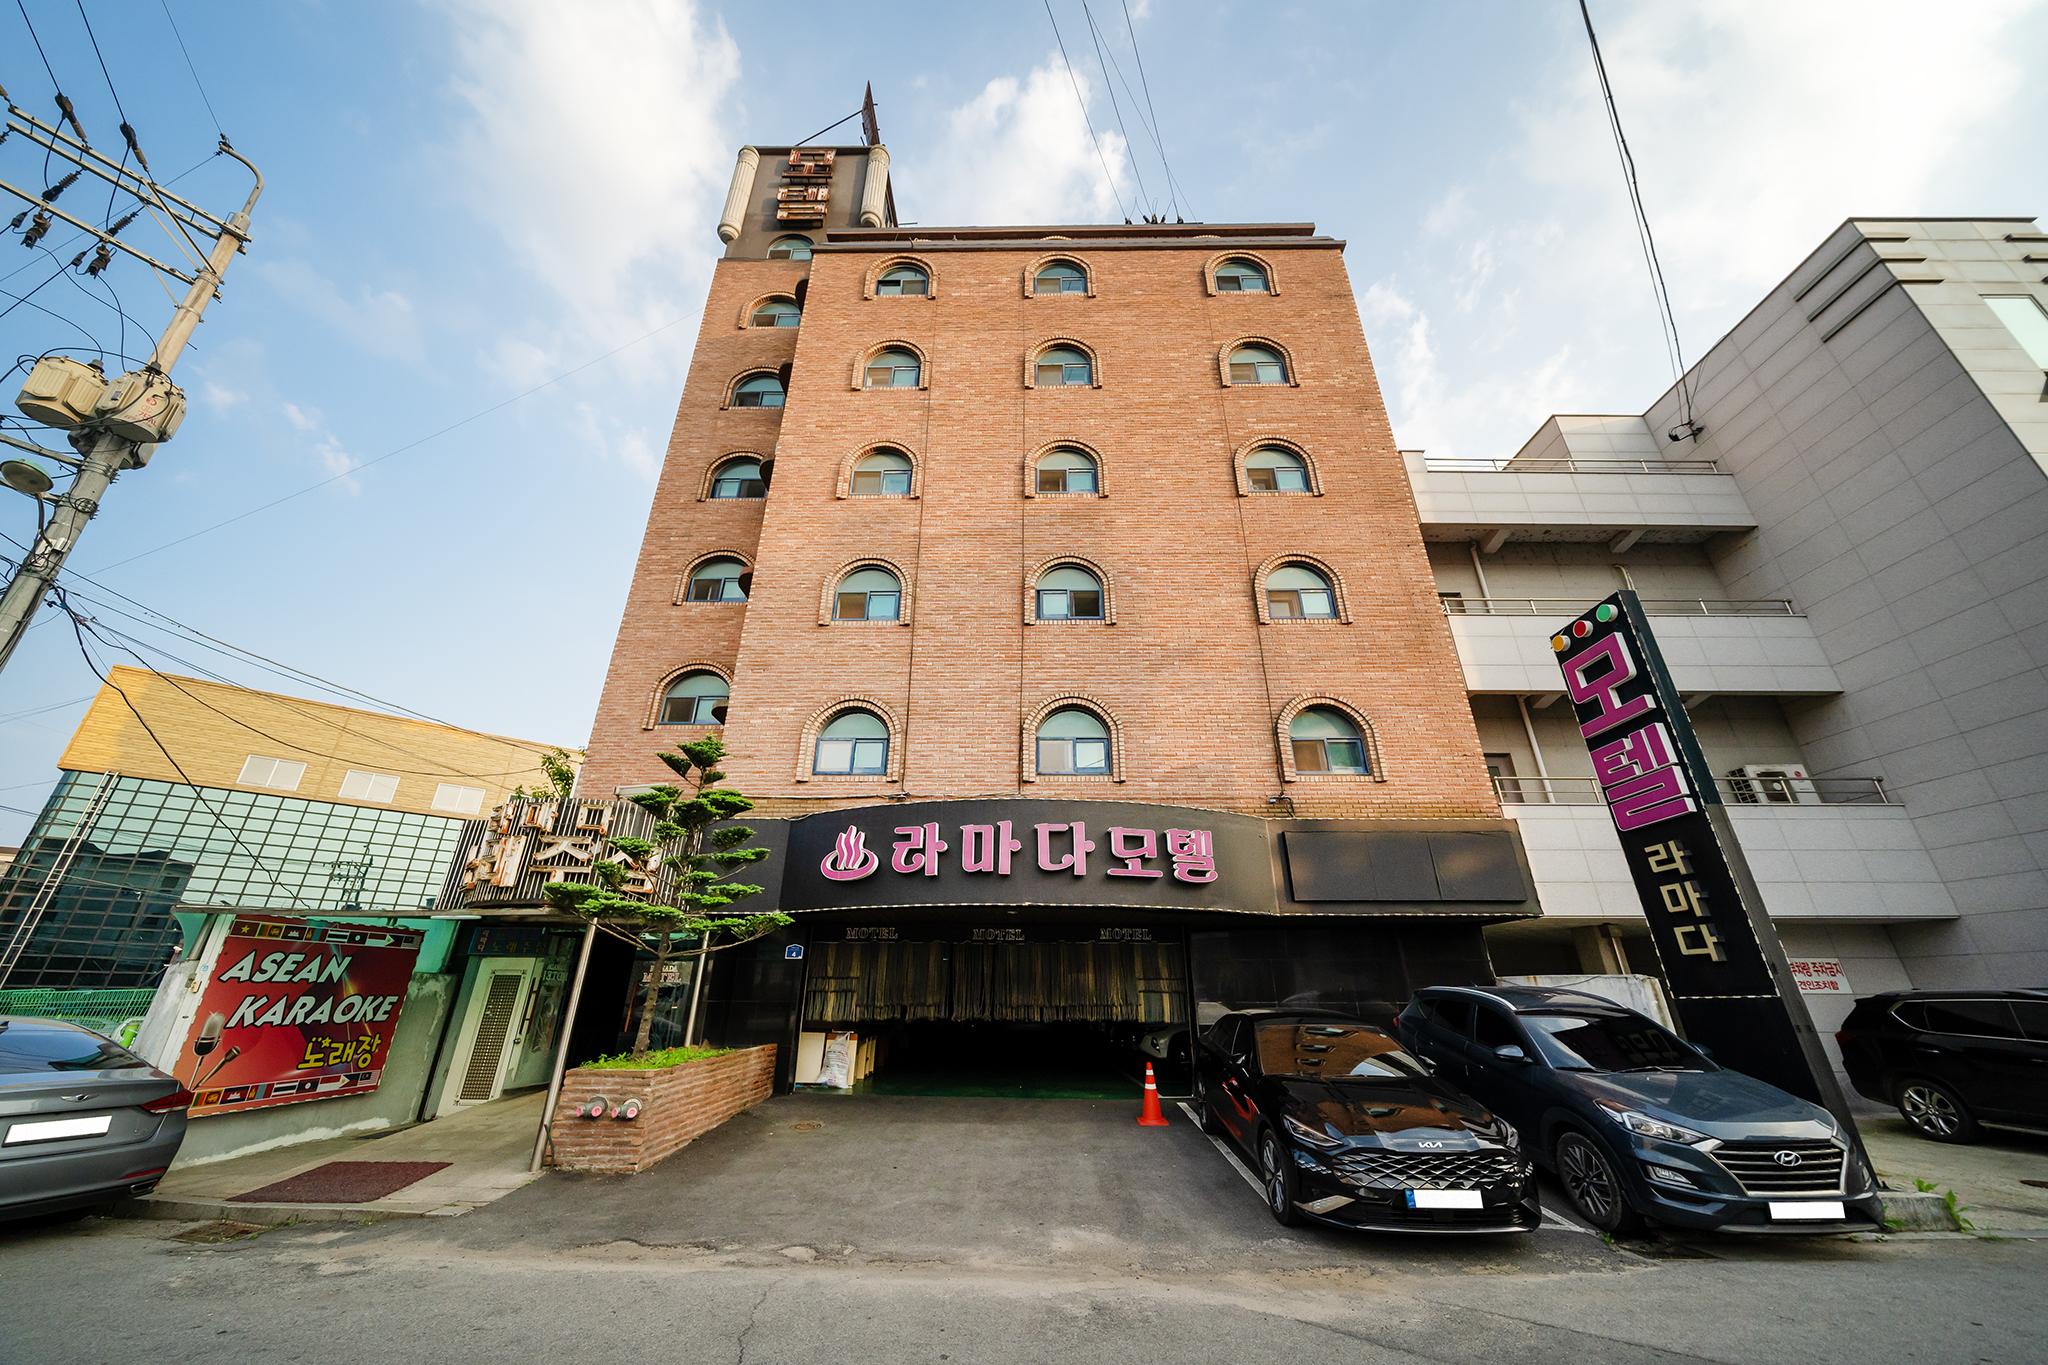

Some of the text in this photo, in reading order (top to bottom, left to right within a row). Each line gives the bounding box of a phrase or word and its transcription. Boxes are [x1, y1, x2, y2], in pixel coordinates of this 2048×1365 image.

[775, 148, 836, 223] 모텔
[1561, 631, 1697, 832] 모텔
[891, 820, 1218, 884] 라마다 모텔
[1643, 839, 1723, 962] 라마다
[845, 927, 898, 939] MOTEL
[972, 928, 1025, 940] MOTEL
[1100, 928, 1152, 941] MOTEL
[219, 949, 352, 984] ASEAN
[641, 972, 682, 983] MTEL
[1810, 962, 1845, 977] 주차금지
[224, 994, 400, 1029] KARAOKE
[297, 1033, 382, 1069] 노래장
